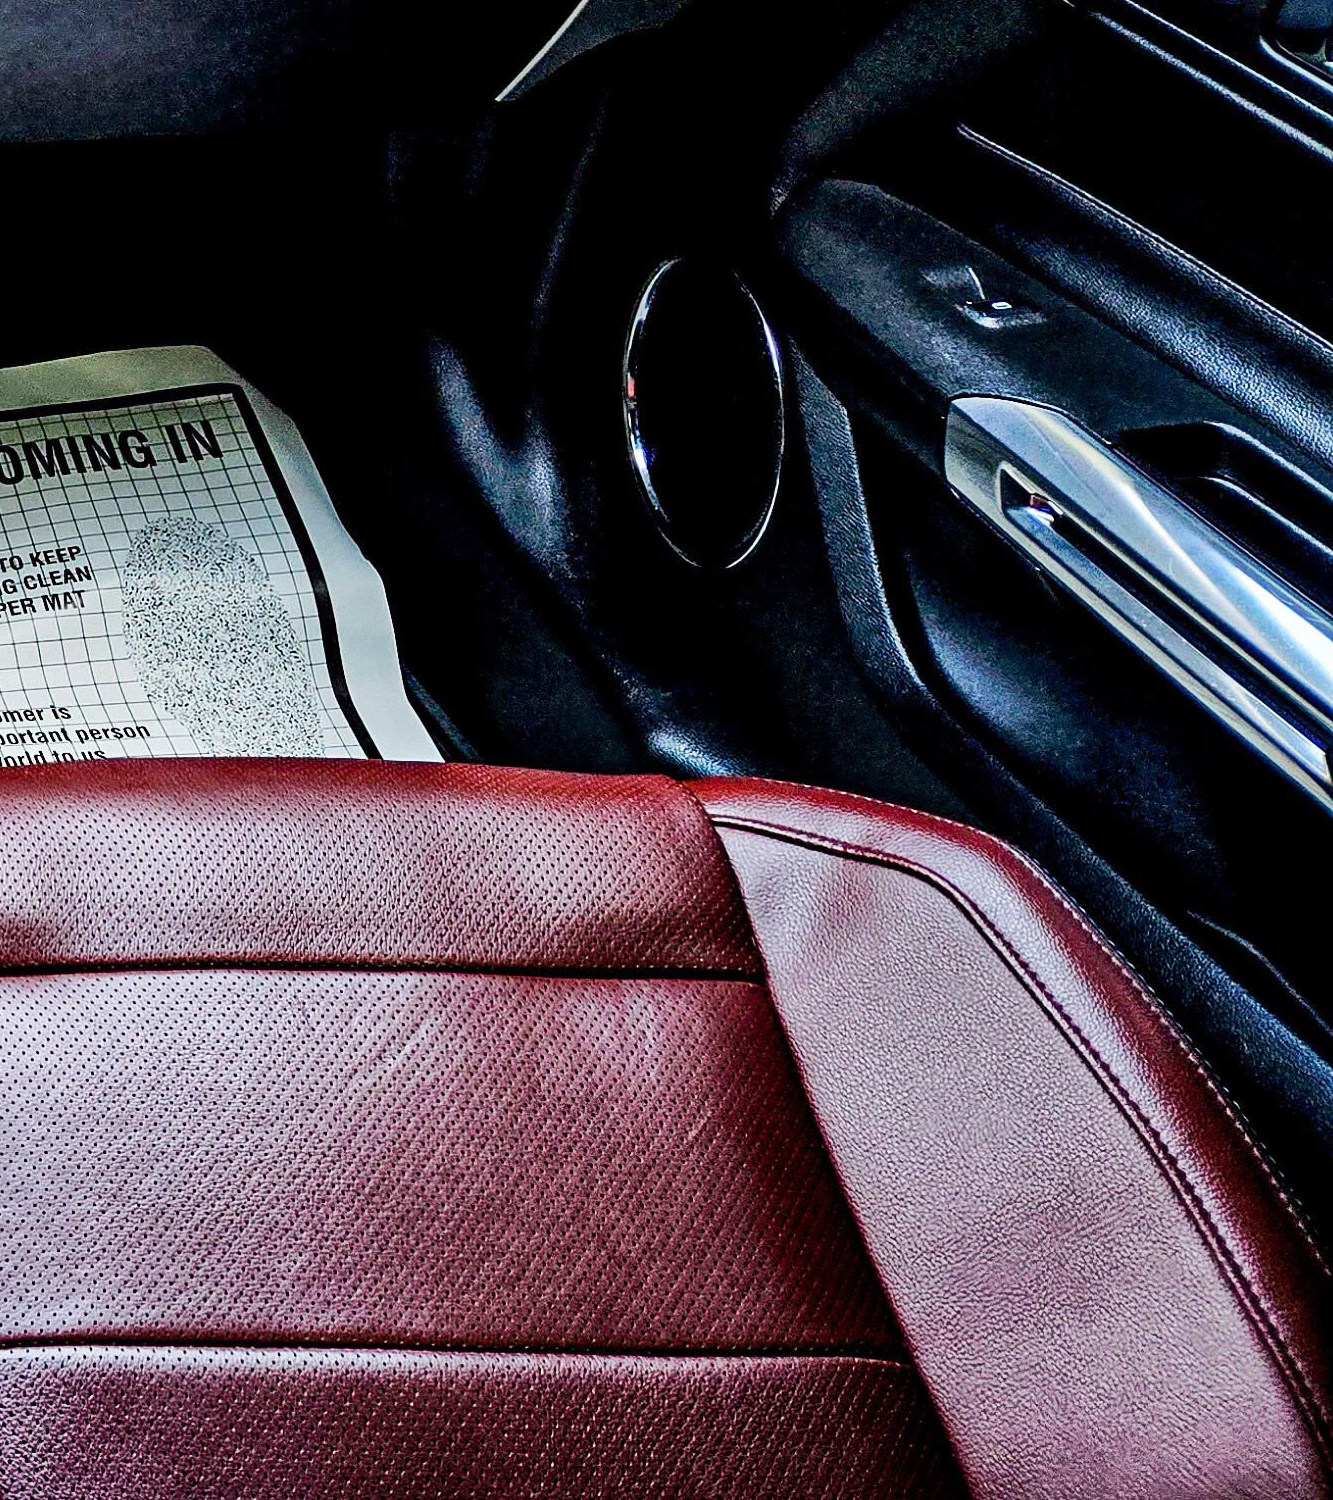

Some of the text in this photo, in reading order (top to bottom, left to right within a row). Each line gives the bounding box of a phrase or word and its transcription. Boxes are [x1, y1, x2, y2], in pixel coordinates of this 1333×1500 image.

[168, 420, 223, 462] IN
[29, 546, 81, 568] KEEP
[22, 566, 92, 591] CLEAN
[40, 589, 86, 612] MAT
[50, 704, 72, 720] is
[76, 724, 151, 745] person
